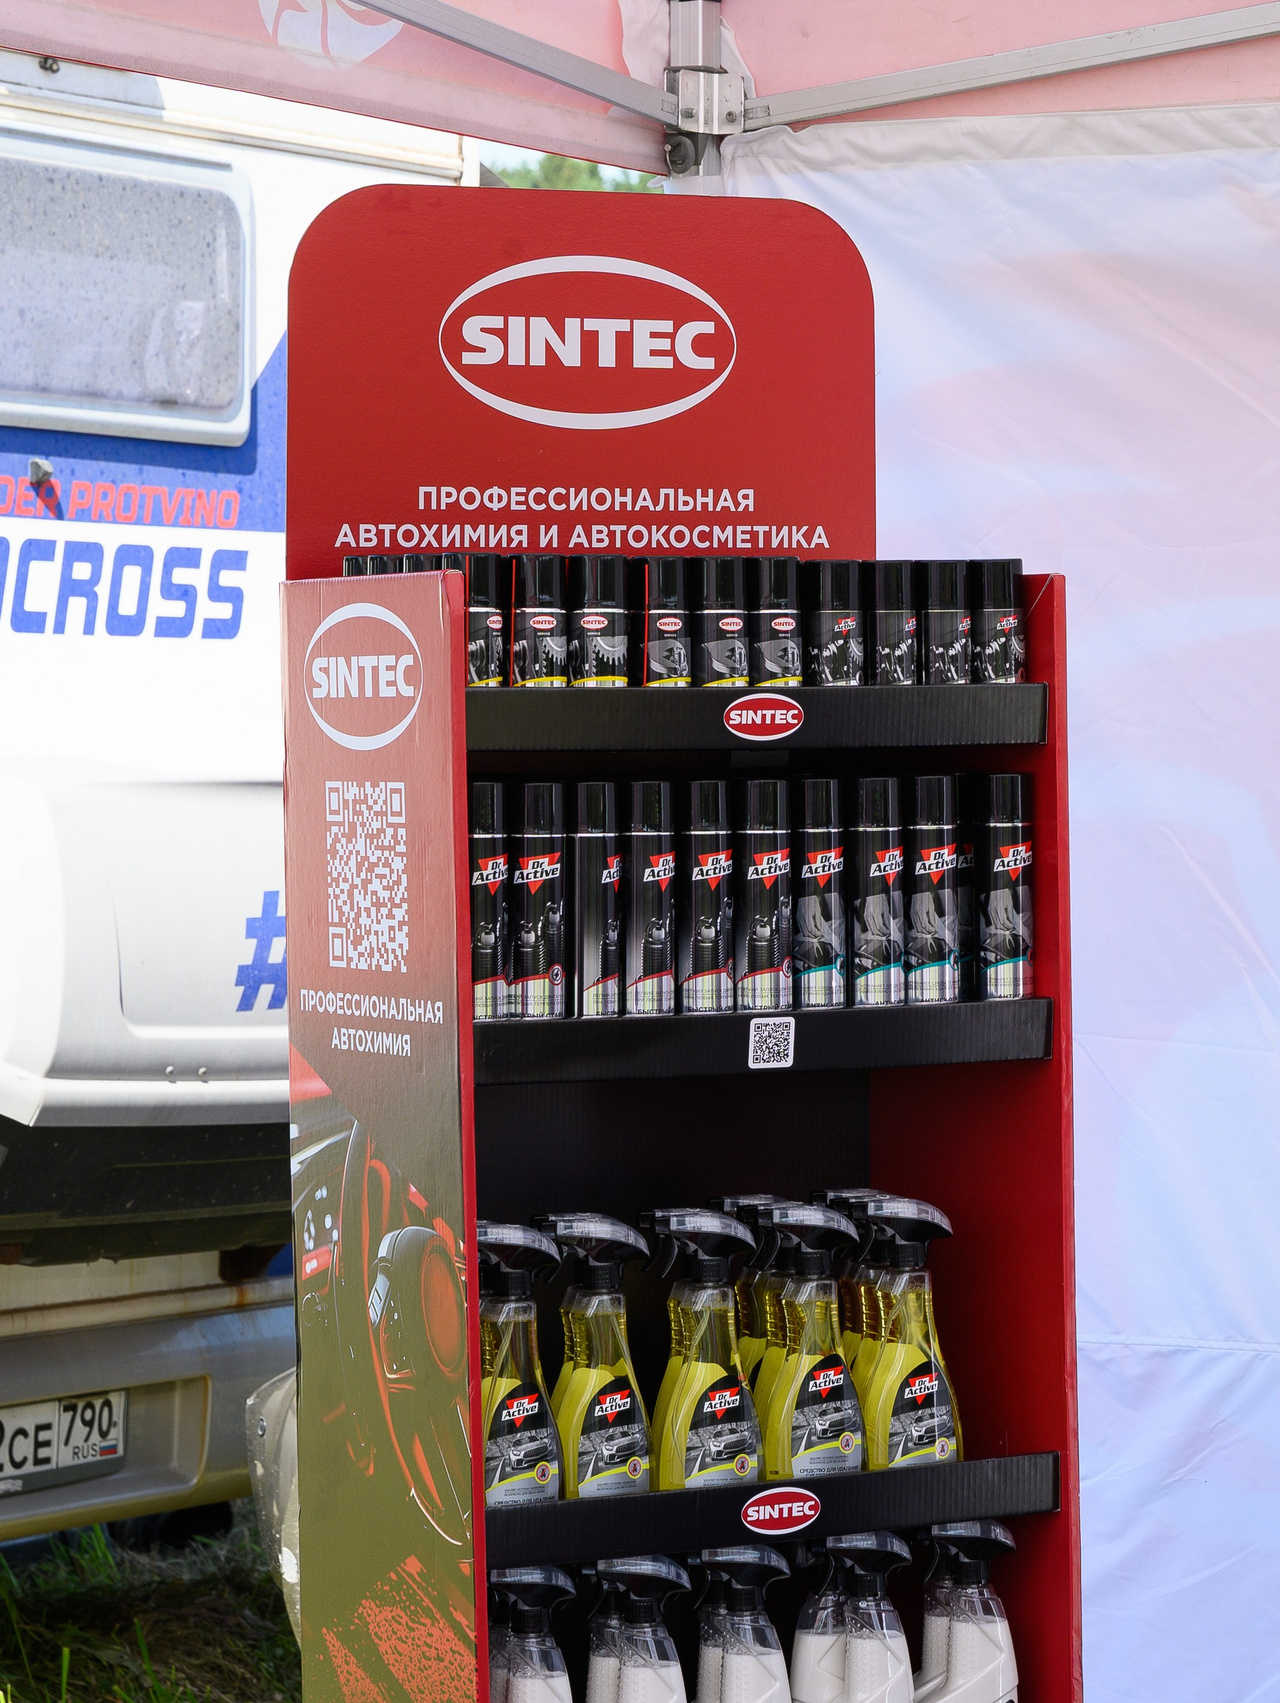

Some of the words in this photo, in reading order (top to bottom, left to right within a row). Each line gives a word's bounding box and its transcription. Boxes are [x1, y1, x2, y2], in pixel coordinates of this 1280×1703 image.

[461, 315, 715, 370] SINTEC
[67, 480, 240, 529] PROTVINO
[418, 485, 755, 513] ПРОФЕССИОНАЛЬНАЯ
[335, 523, 527, 549] АВТОХИМИЯ
[540, 524, 559, 548] И
[568, 524, 830, 550] АВТОКОСМЕТИКА
[312, 654, 415, 699] SINTEC
[729, 709, 799, 725] SINTEC
[766, 856, 778, 865] Dr
[820, 855, 832, 864] Dr
[888, 852, 898, 862] Dr
[934, 851, 945, 861] Dr
[1012, 848, 1023, 858] Dr
[491, 860, 502, 870] Dr
[531, 860, 545, 870] Dr
[662, 858, 671, 867] Dr
[711, 857, 723, 866] Dr
[803, 860, 843, 877] Active
[916, 857, 956, 874] Active
[995, 854, 1032, 871] Active
[515, 866, 559, 882] Active
[694, 862, 732, 879] Active
[749, 861, 789, 878] Active
[300, 989, 443, 1024] ПРОФЕССИОНАЛЬНАЯ
[331, 1026, 411, 1057] АВТОХИМИЯ
[810, 1376, 842, 1390] Active
[822, 1371, 832, 1380] Dr
[917, 1378, 927, 1387] Dr
[717, 1393, 728, 1401] Dr
[906, 1382, 937, 1397] Active
[515, 1399, 526, 1409] Dr
[596, 1400, 629, 1415] Active
[608, 1395, 619, 1405] Dr
[705, 1397, 738, 1411] Active
[503, 1405, 537, 1420] Active
[0, 1419, 53, 1473] CE
[62, 1398, 113, 1447] 790
[72, 1443, 98, 1460] RUS
[746, 1500, 816, 1522] SINTEC
